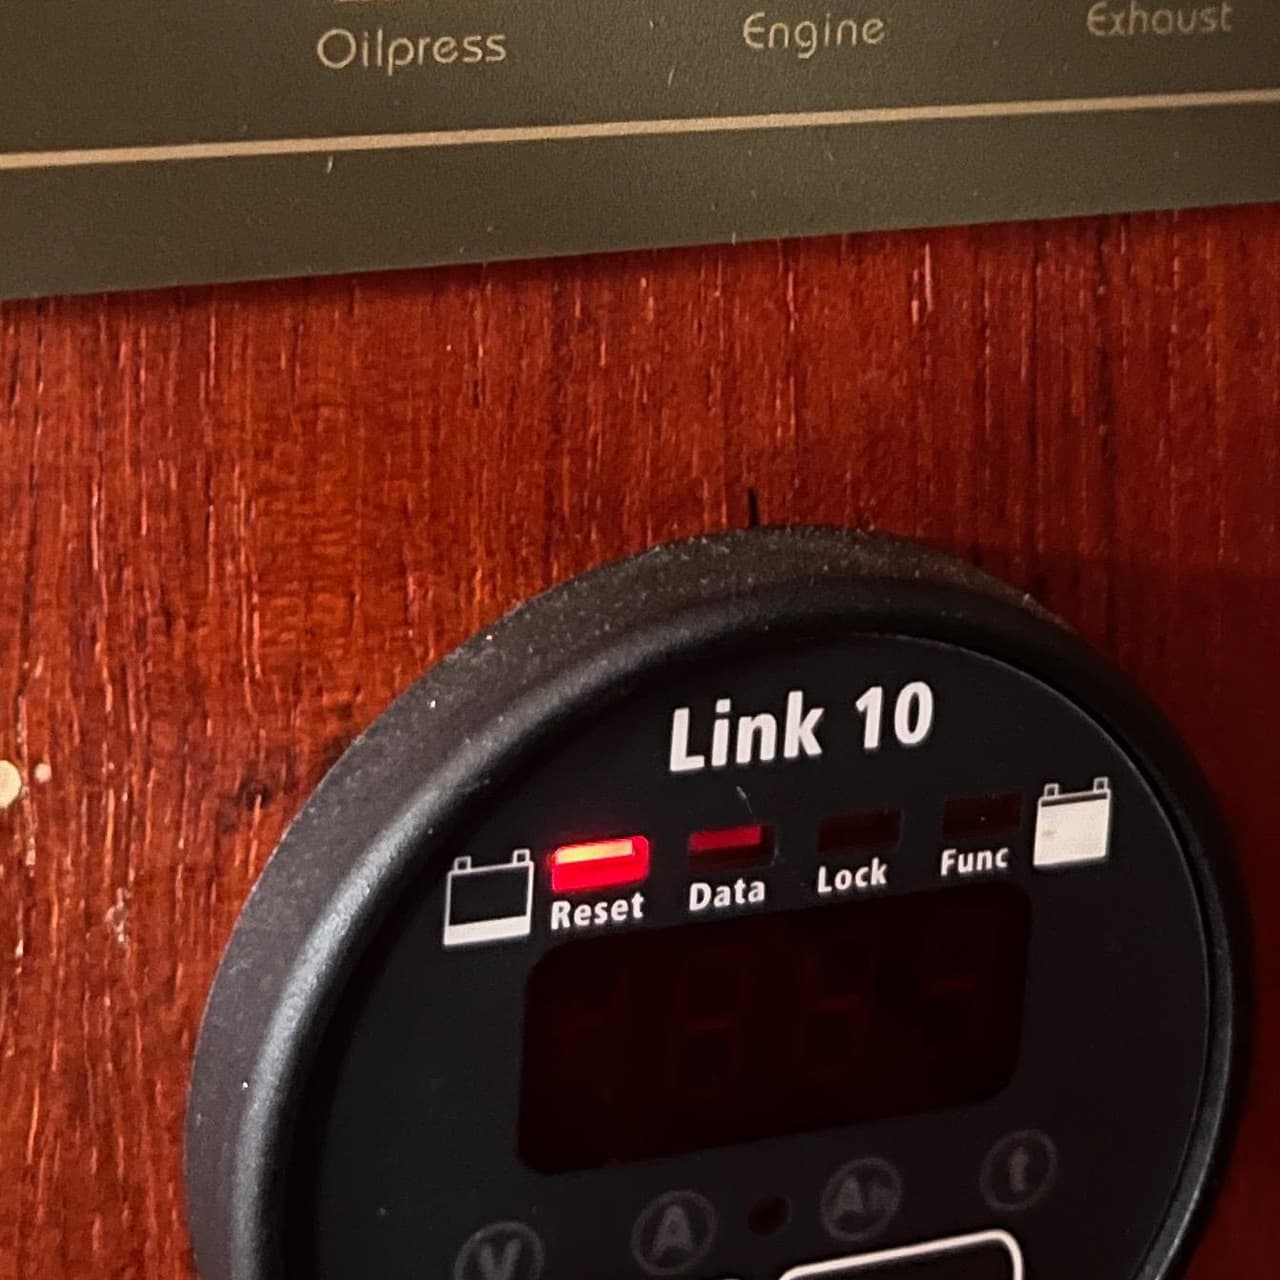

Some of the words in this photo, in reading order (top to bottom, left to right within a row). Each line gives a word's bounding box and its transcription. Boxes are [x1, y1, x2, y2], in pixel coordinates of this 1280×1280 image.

[742, 12, 886, 60] Engine
[1086, 0, 1234, 38] Exhaust
[317, 27, 508, 77] Oilpress
[669, 690, 825, 772] Link
[855, 680, 934, 750] 10
[816, 856, 888, 894] Lock
[940, 846, 1009, 877] Func
[550, 892, 645, 931] Reset
[688, 877, 767, 912] Data
